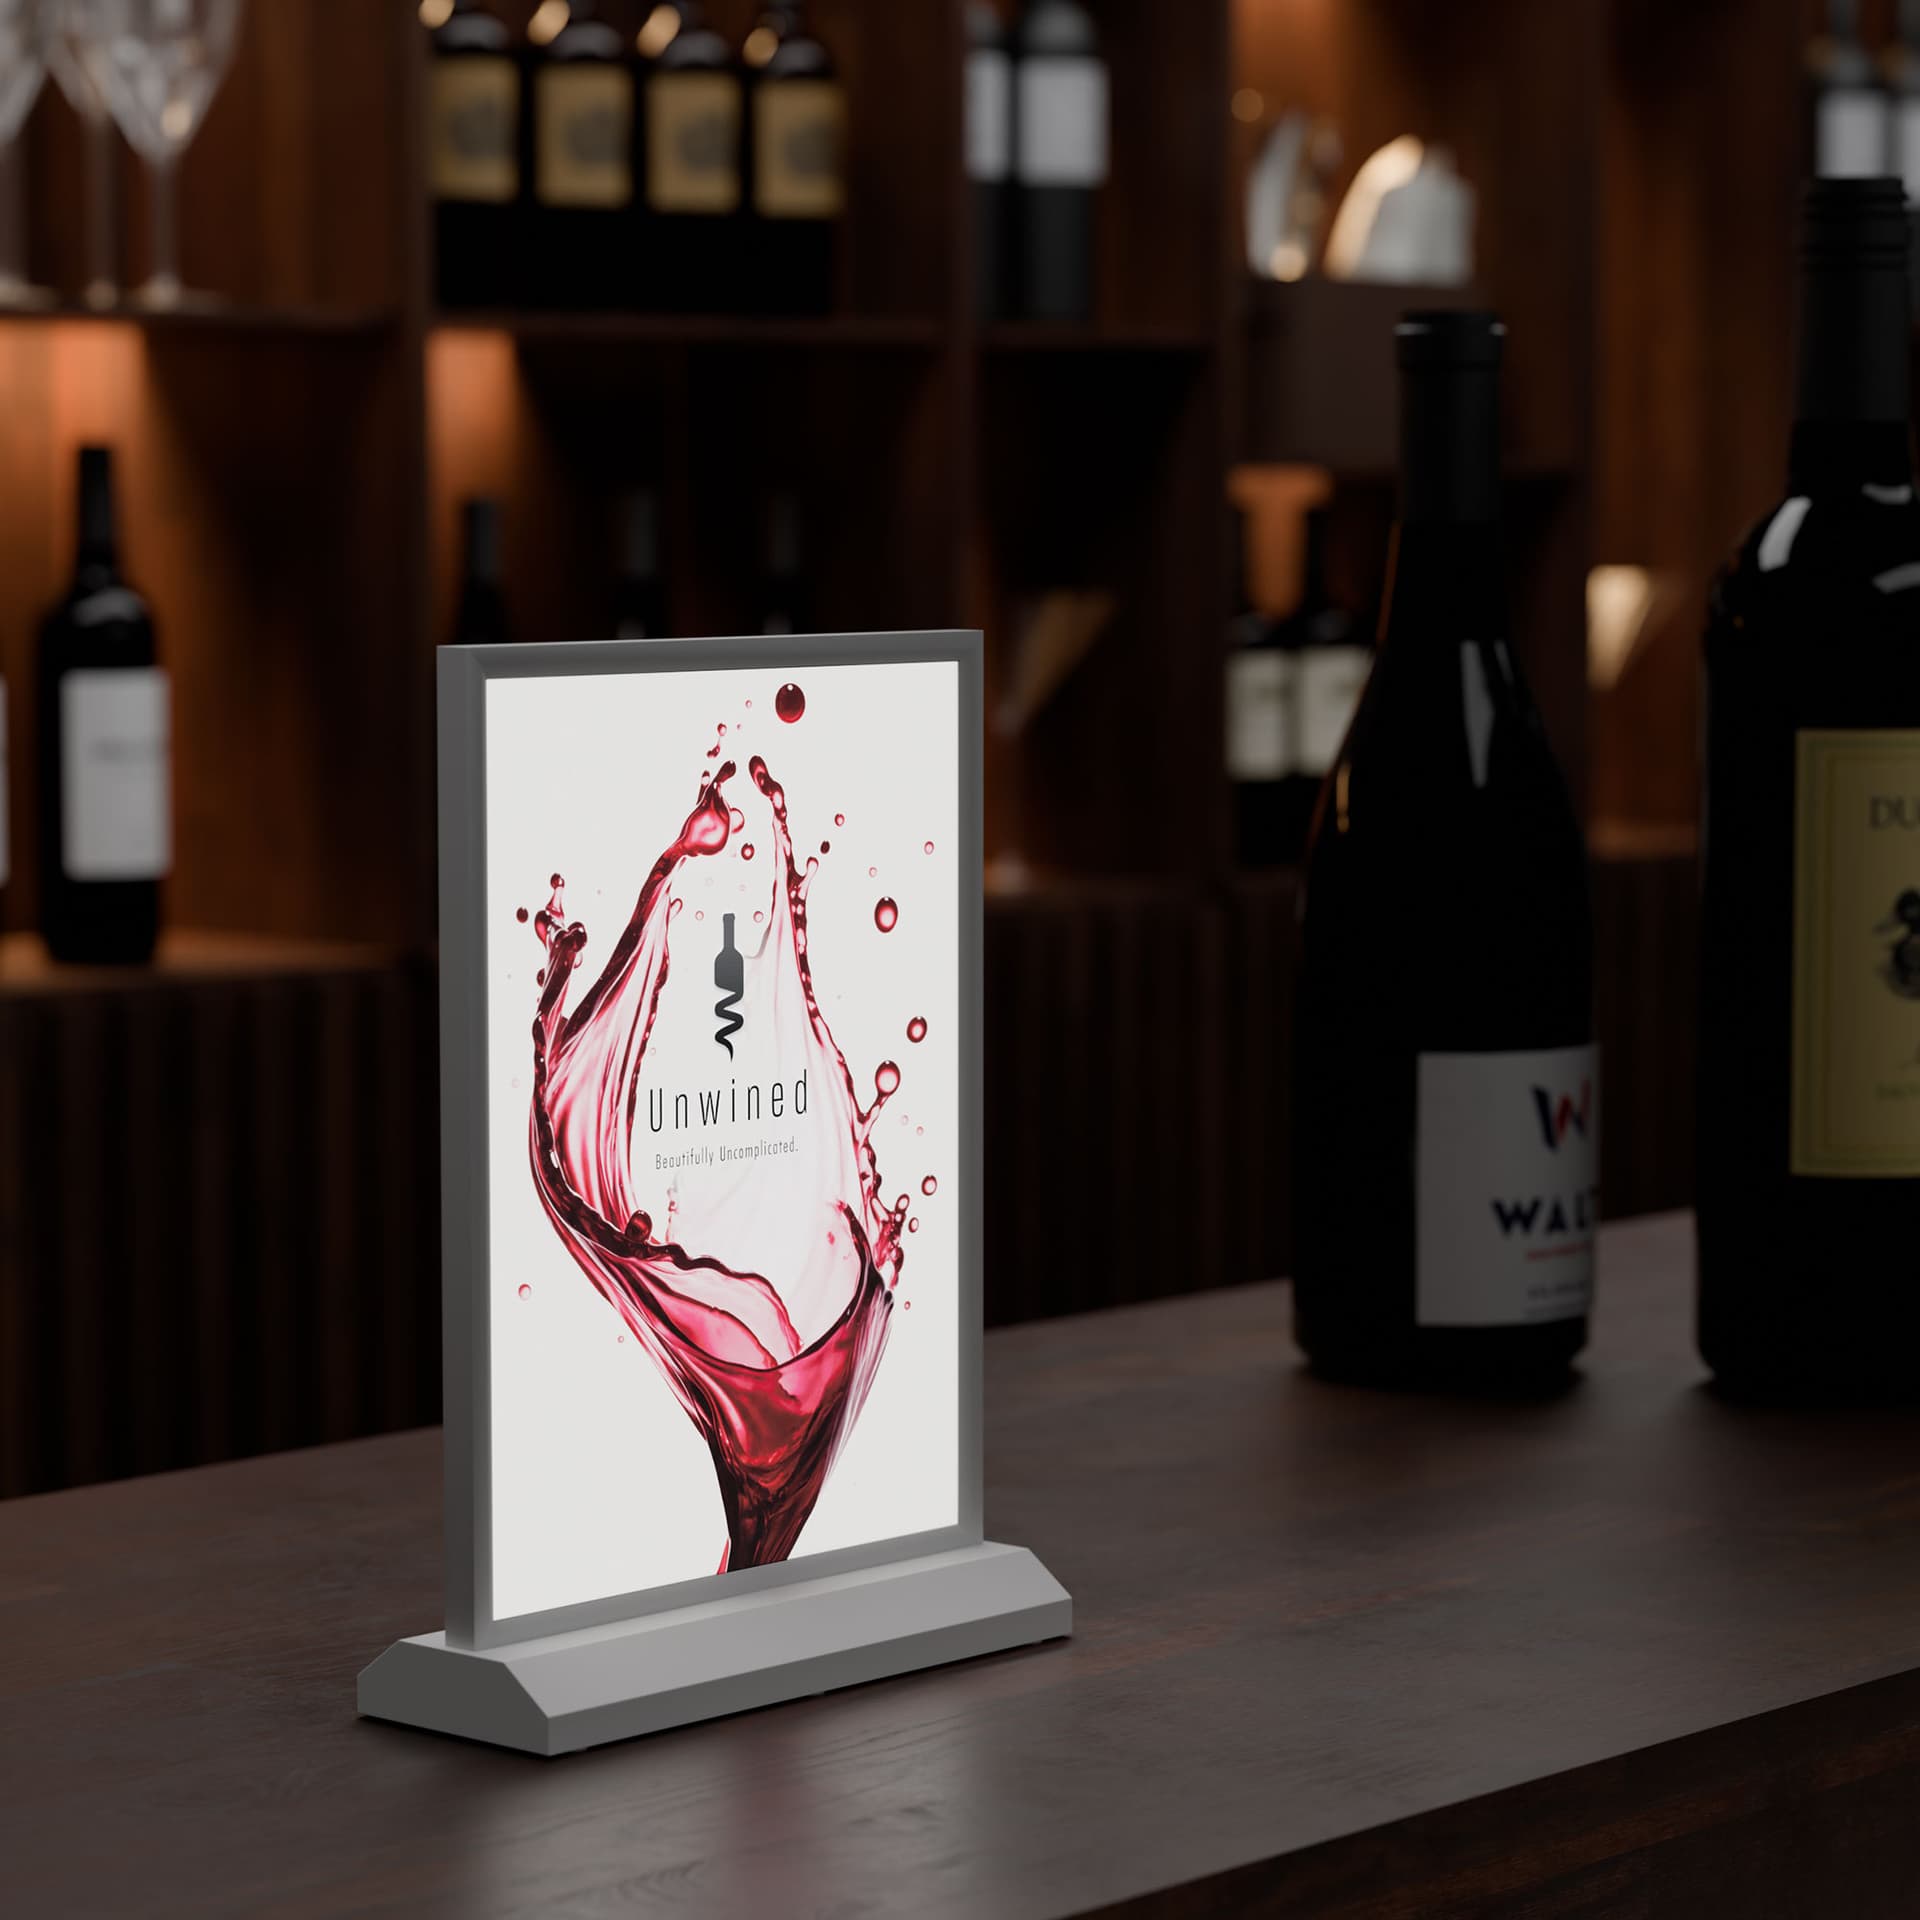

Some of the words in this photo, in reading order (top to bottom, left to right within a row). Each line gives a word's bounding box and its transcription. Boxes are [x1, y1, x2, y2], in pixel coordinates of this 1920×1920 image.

[1867, 795, 1920, 830] DU
[650, 1068, 807, 1132] Unwined
[655, 1147, 714, 1170] Beautifully
[719, 1136, 799, 1162] Uncomplicated.
